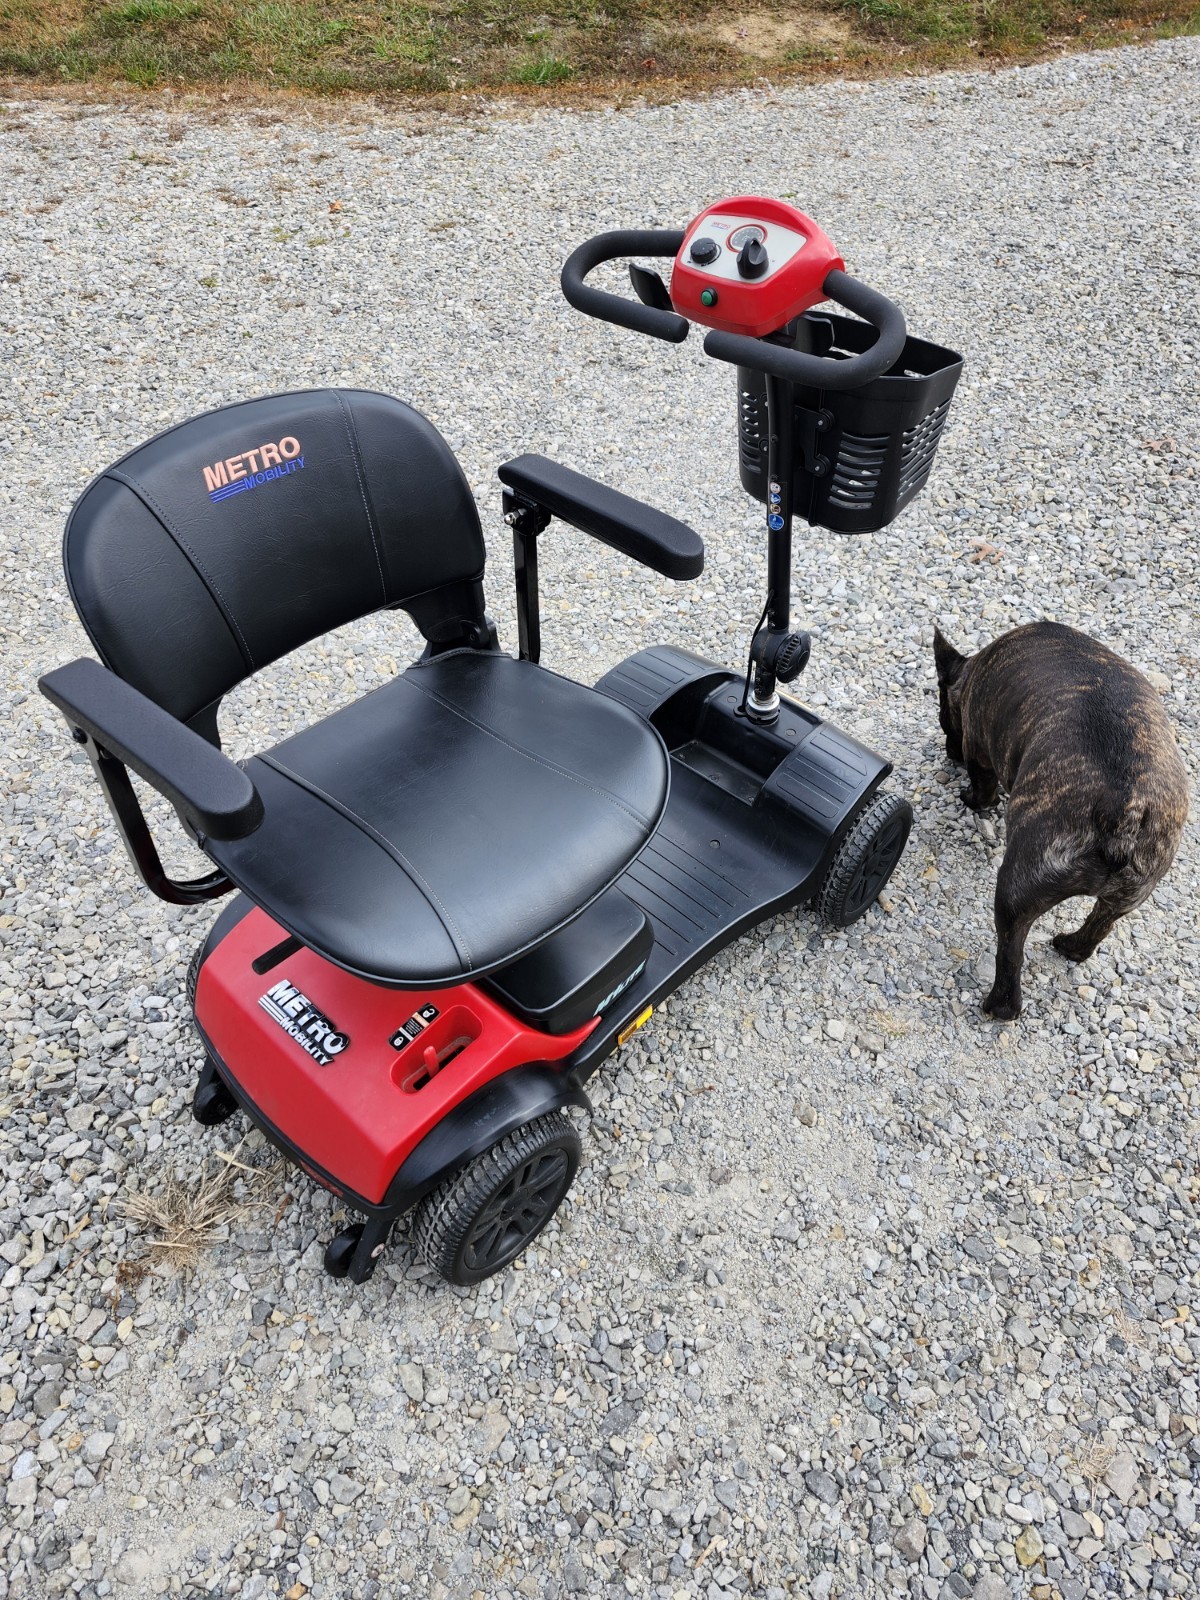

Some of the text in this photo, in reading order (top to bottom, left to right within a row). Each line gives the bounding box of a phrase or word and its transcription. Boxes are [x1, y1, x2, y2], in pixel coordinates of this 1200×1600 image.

[202, 436, 301, 492] METRO
[243, 456, 306, 490] MOBILITY
[266, 979, 349, 1055] METRO
[279, 1016, 334, 1066] MOBILITY
